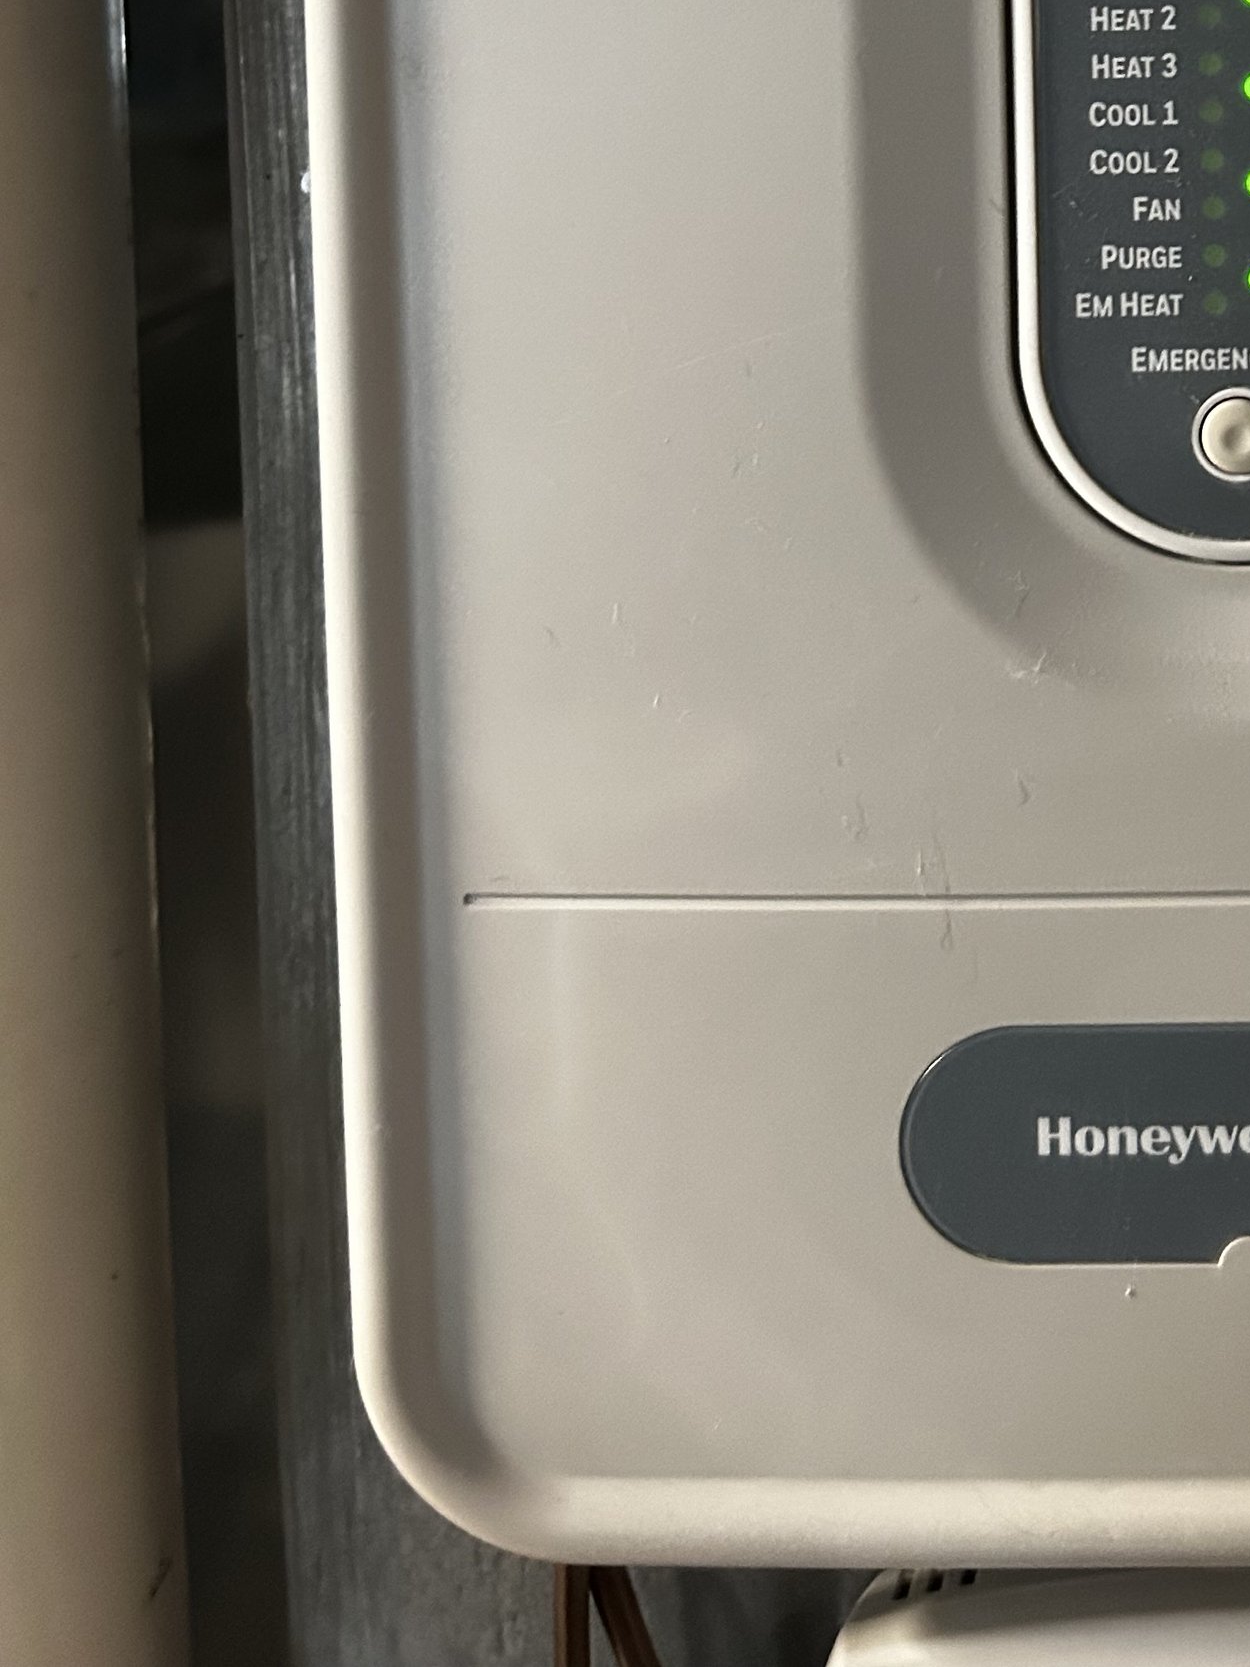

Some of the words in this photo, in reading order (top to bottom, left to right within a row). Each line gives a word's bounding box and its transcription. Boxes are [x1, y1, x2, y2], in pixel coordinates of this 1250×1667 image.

[1090, 6, 1154, 32] HEAT
[1160, 5, 1177, 31] 2
[1091, 53, 1155, 79] HEAT
[1161, 52, 1178, 78] 3
[1088, 101, 1156, 128] COOL
[1162, 100, 1179, 126] 1
[1089, 149, 1158, 175] COOL
[1163, 147, 1180, 174] 2
[1133, 196, 1181, 222] FAN
[1101, 244, 1183, 270] PURGE
[1075, 292, 1113, 318] EM
[1120, 291, 1184, 317] HEAT
